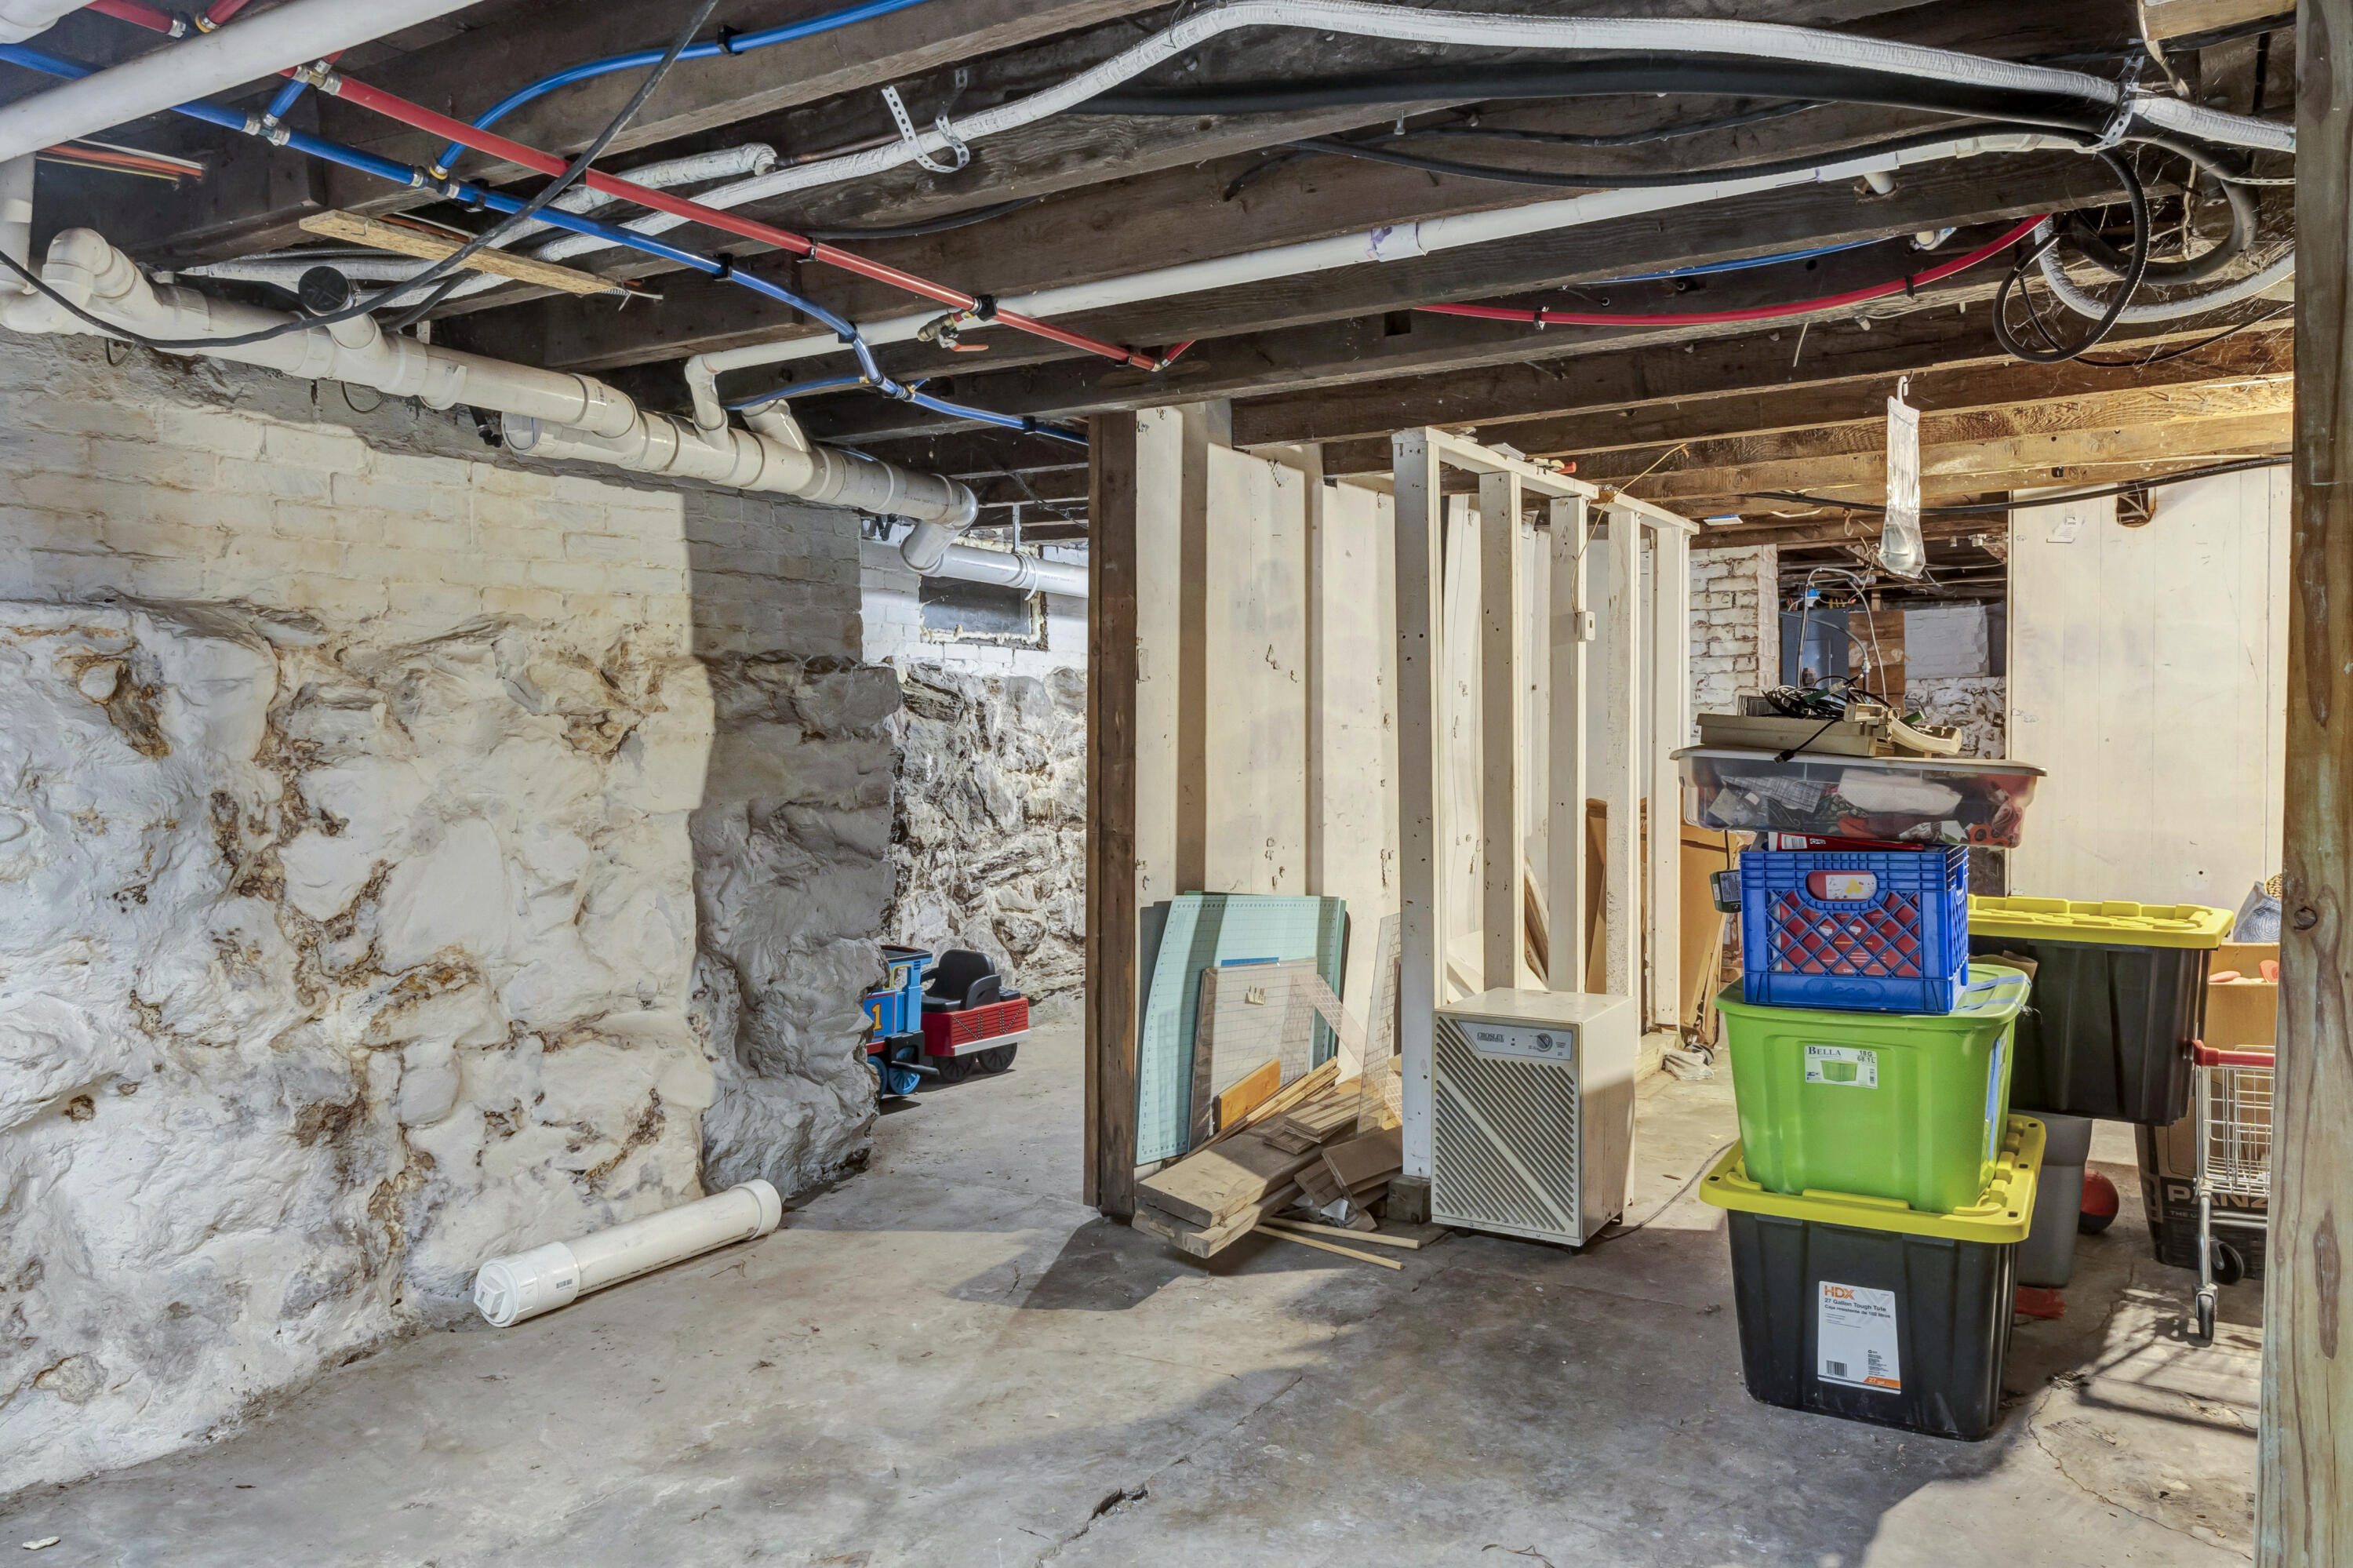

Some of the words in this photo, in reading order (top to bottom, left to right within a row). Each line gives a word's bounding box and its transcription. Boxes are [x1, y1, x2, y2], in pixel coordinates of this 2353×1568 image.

[871, 1002, 883, 1031] 1
[1808, 1046, 1842, 1056] BELLA
[1824, 1285, 1856, 1301] HDX
